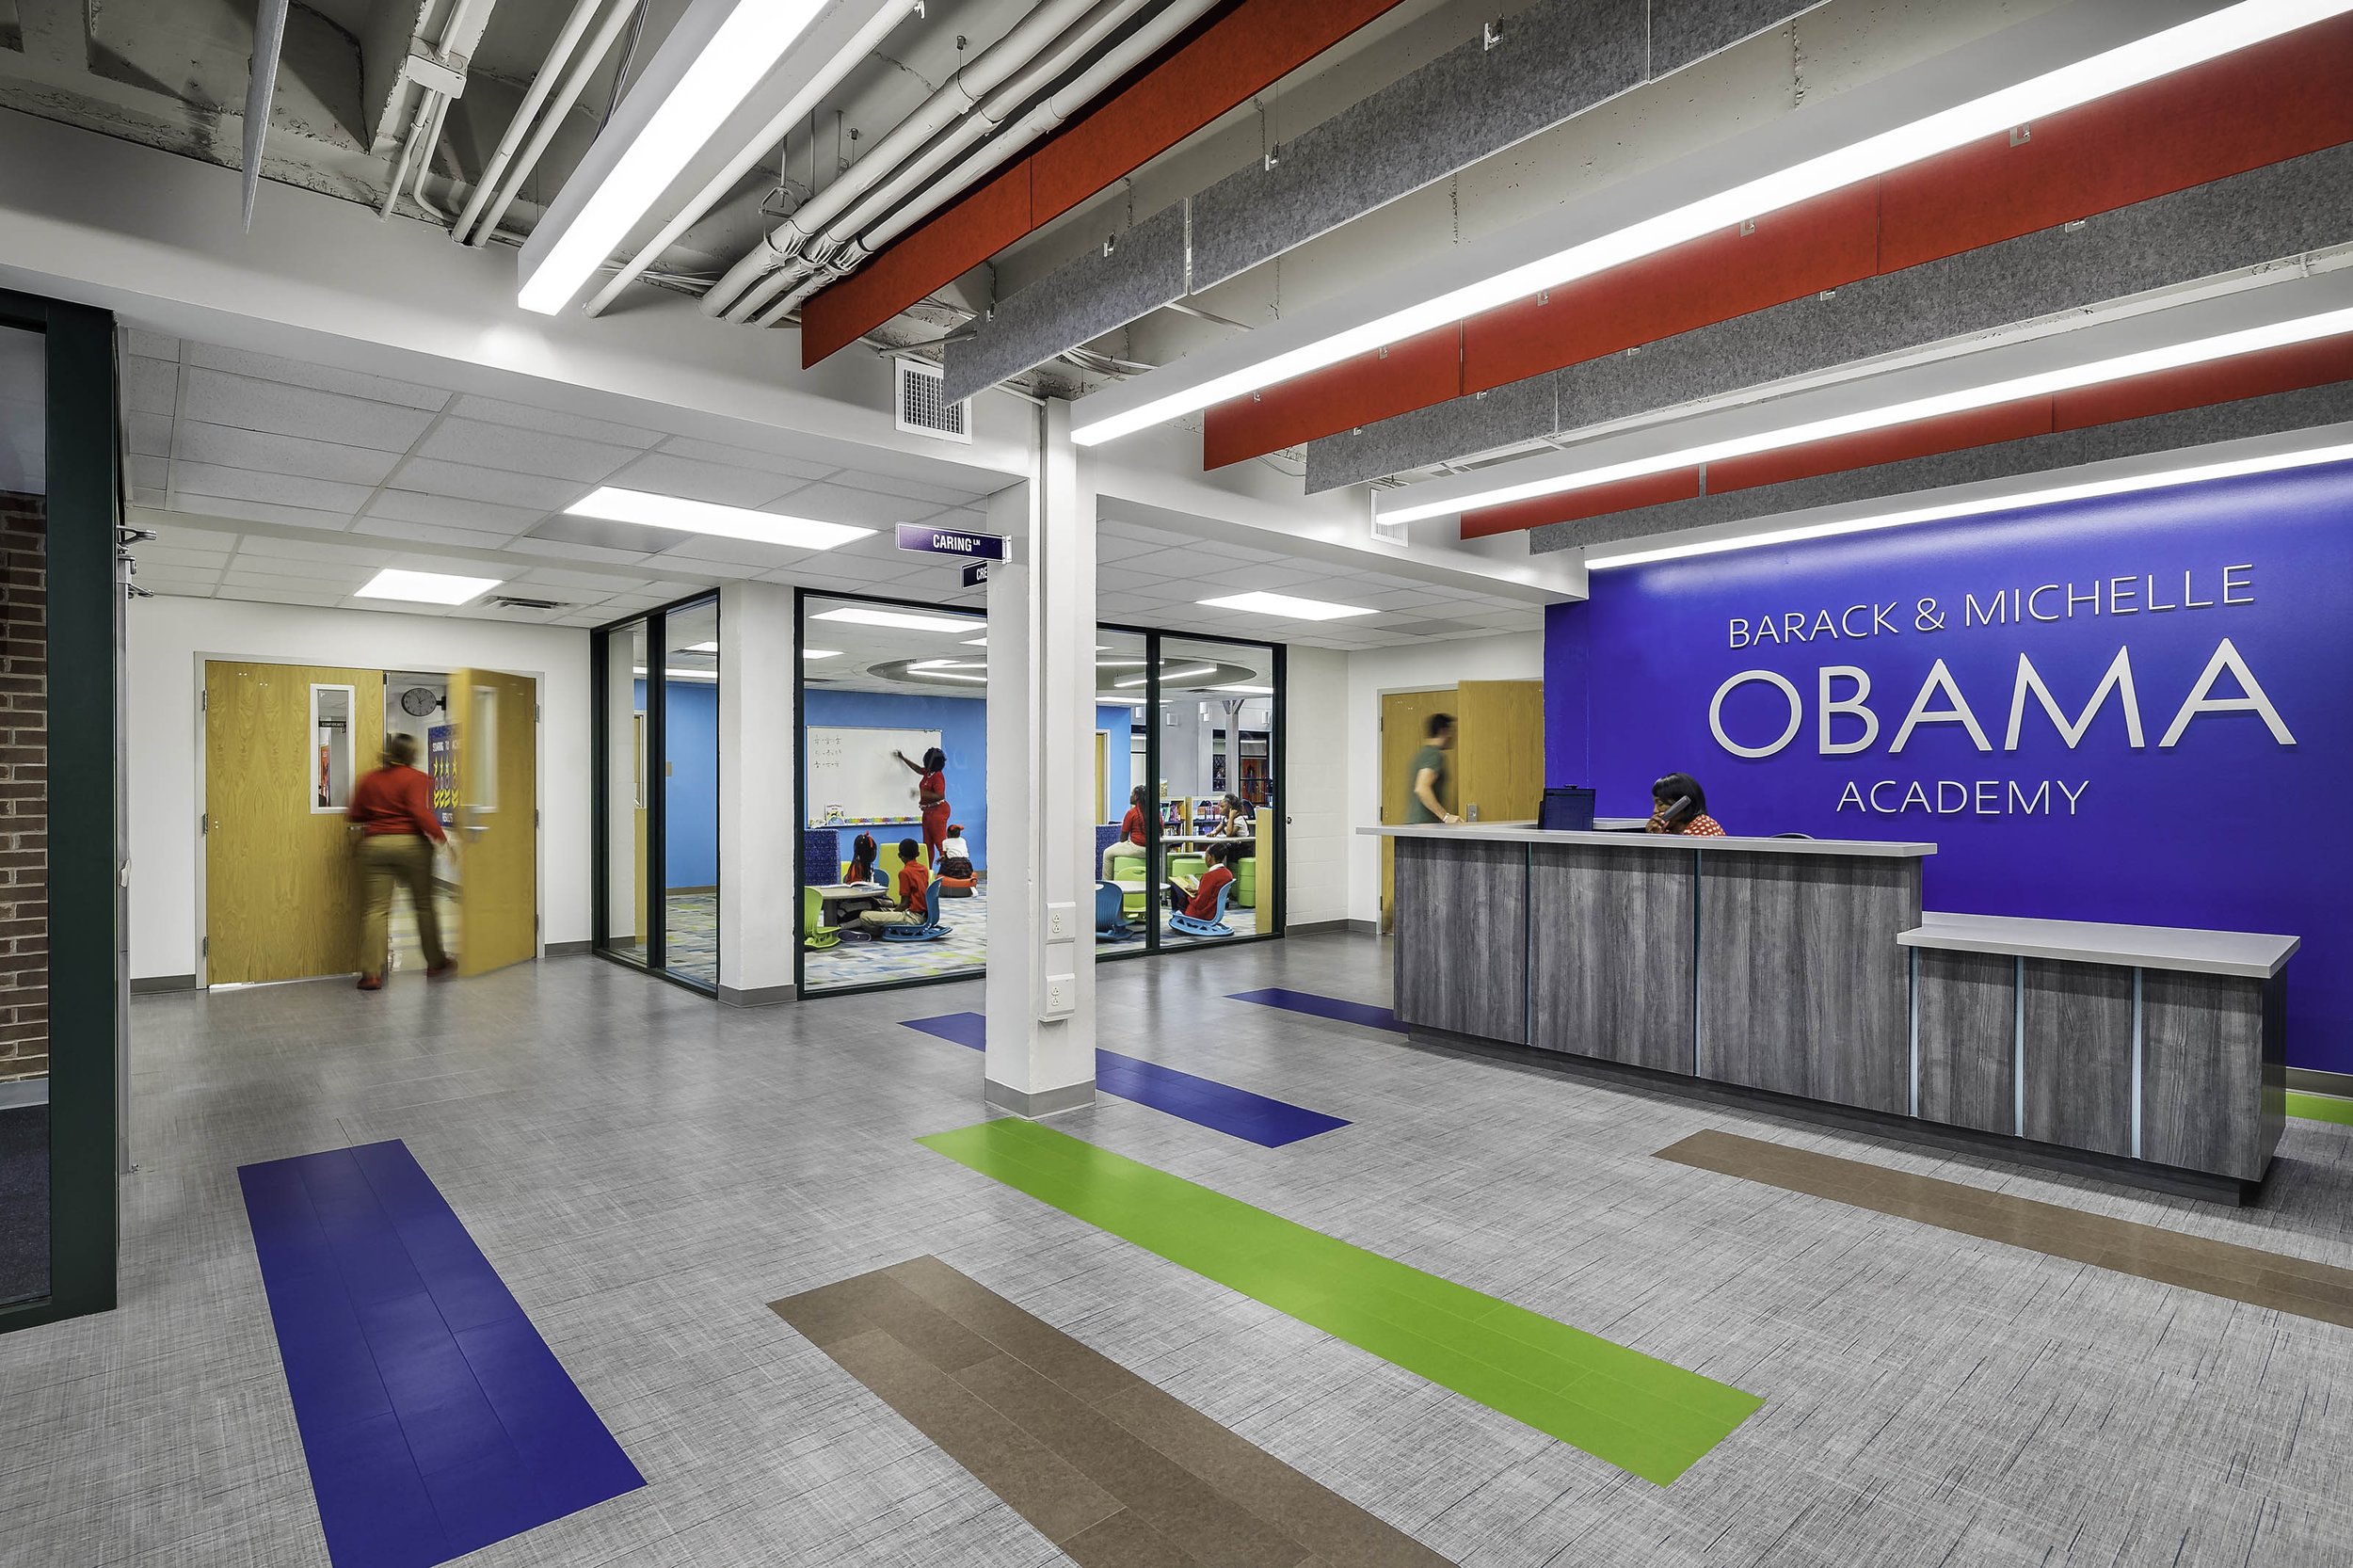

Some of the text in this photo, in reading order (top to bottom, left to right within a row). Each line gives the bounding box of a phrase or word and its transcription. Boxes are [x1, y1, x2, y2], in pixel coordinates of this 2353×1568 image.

[933, 534, 972, 552] CARING
[1729, 564, 2255, 648] BARACK & MICHELLE
[1708, 637, 2297, 758] OBAMA
[1836, 779, 2089, 815] ACADEMY
